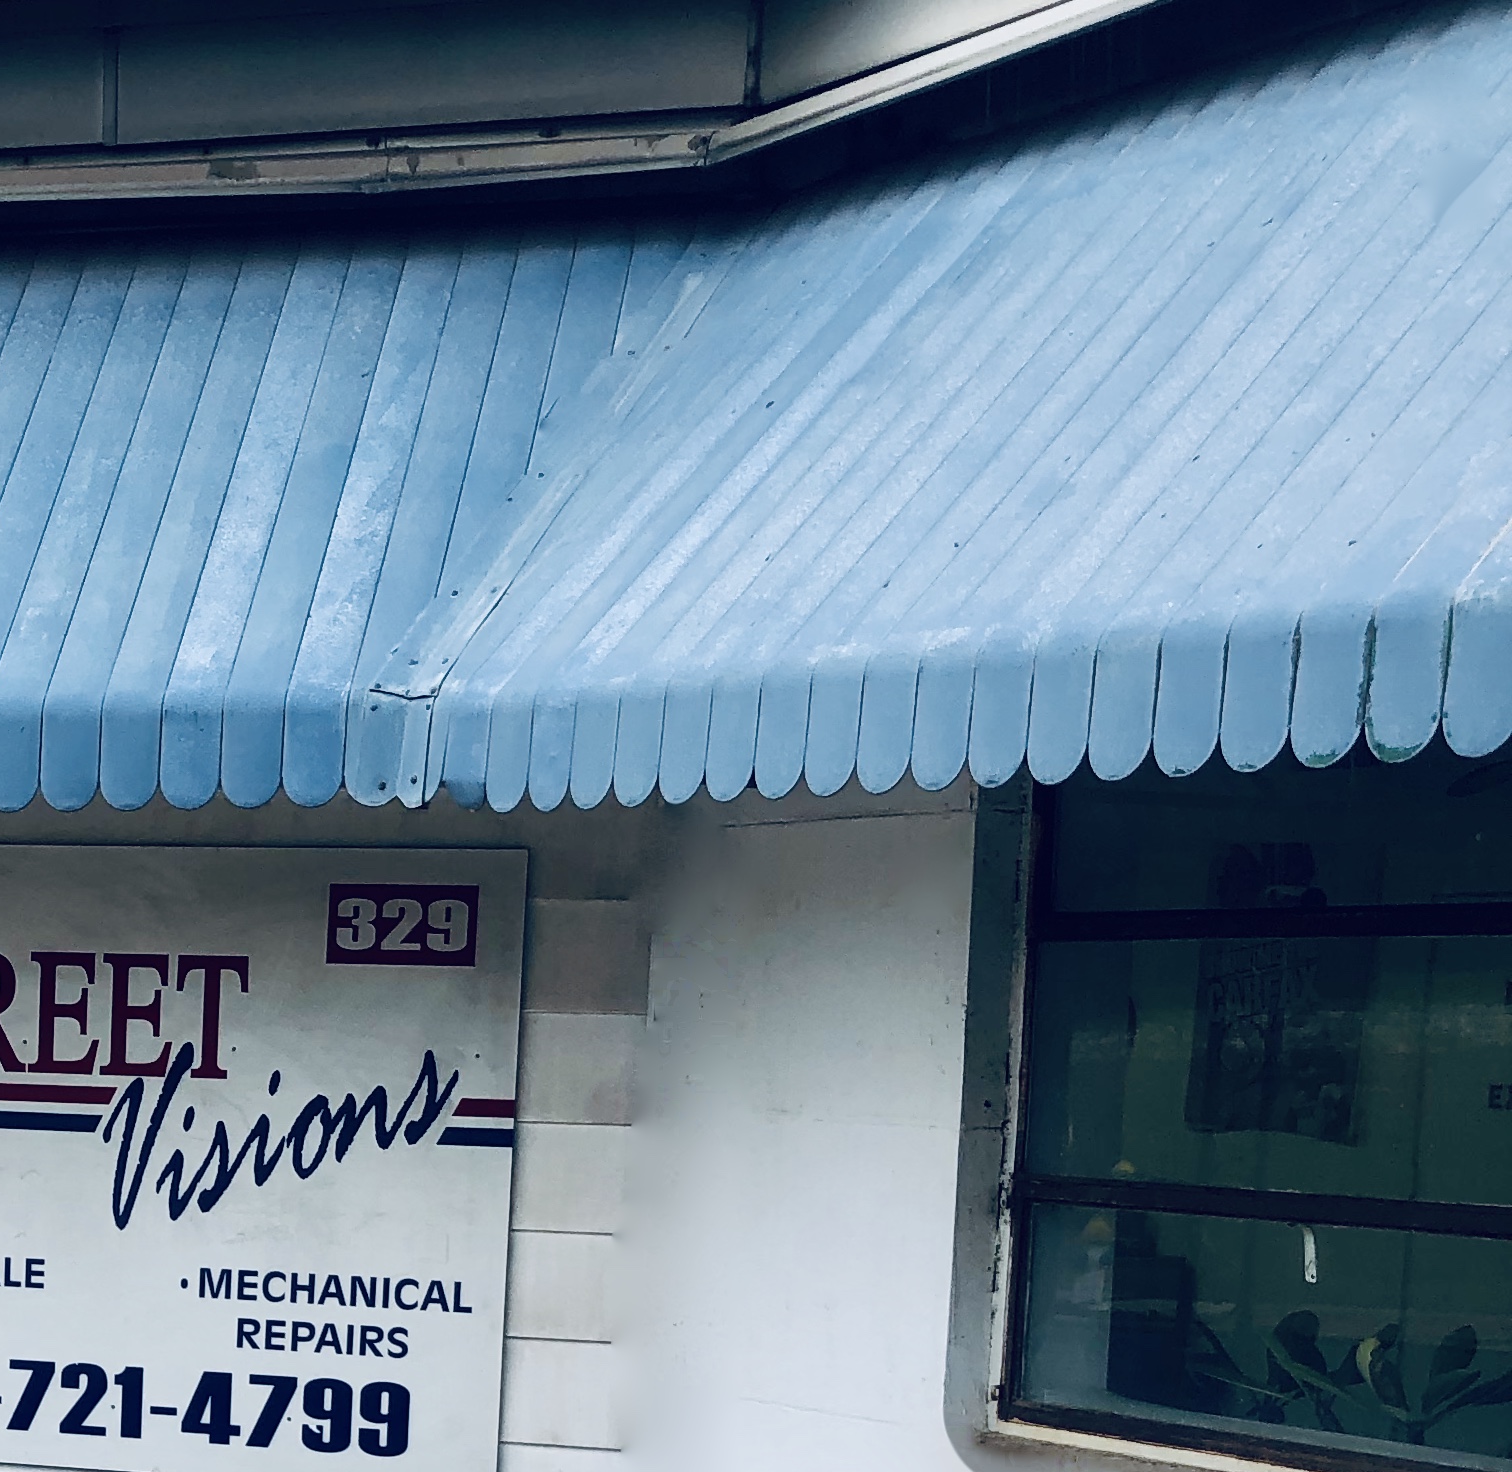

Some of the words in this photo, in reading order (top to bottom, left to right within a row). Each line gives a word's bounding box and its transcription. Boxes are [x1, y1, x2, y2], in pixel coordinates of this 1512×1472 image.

[334, 897, 471, 954] 329
[101, 1041, 460, 1231] Visions
[197, 1267, 473, 1314] MECHANICAL
[235, 1318, 410, 1359] REPAIRS
